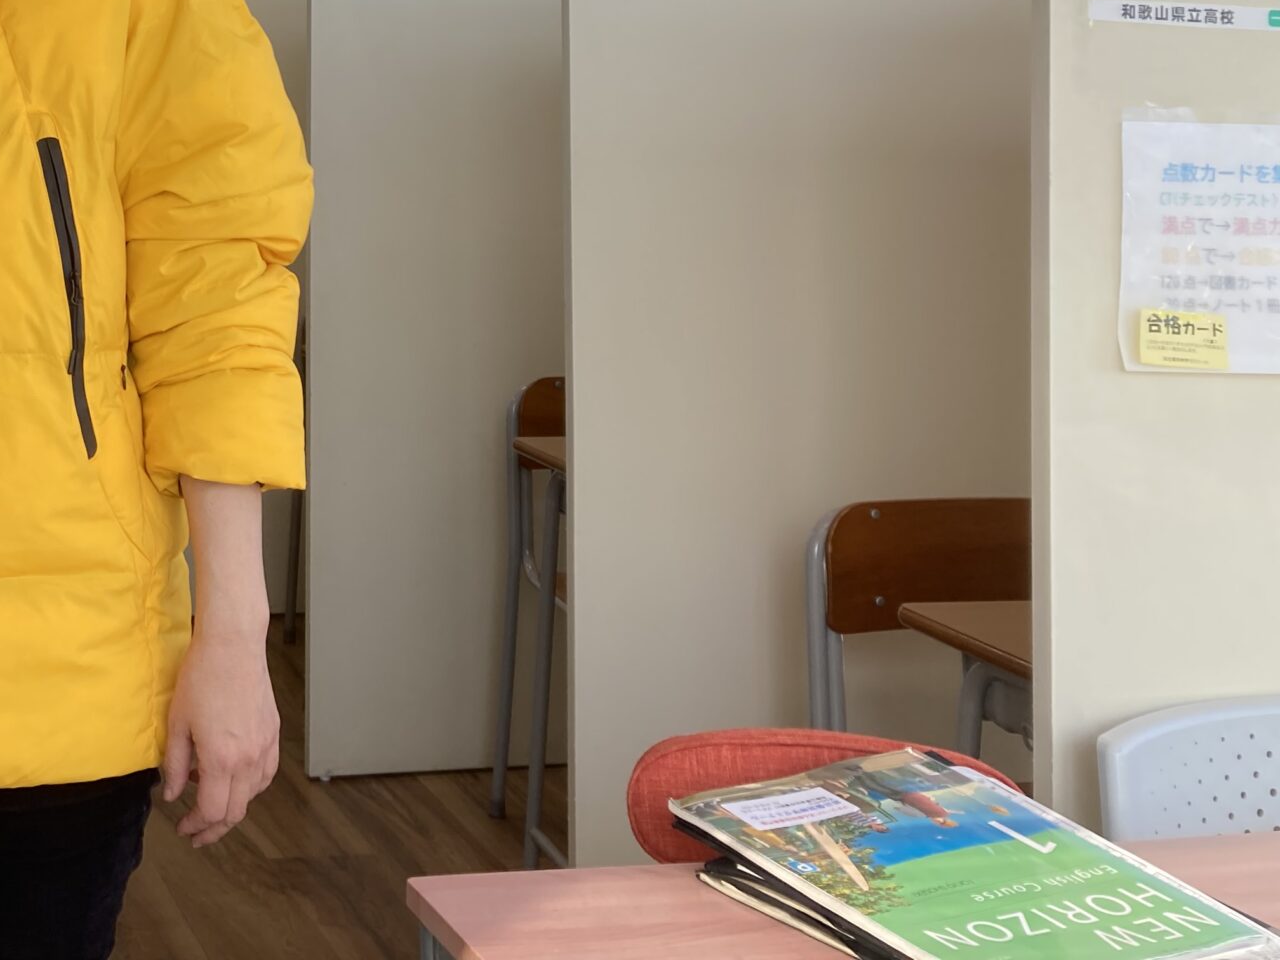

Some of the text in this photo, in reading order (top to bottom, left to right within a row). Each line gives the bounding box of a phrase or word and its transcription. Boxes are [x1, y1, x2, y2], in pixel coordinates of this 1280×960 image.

[1121, 3, 1235, 25] 和歌山県立高校
[1146, 313, 1224, 337] 合格カード
[988, 820, 1057, 854] 1
[1042, 864, 1119, 889] English
[970, 882, 1042, 903] Course
[924, 882, 1172, 951] HORIZON
[1094, 905, 1221, 951] NEW
